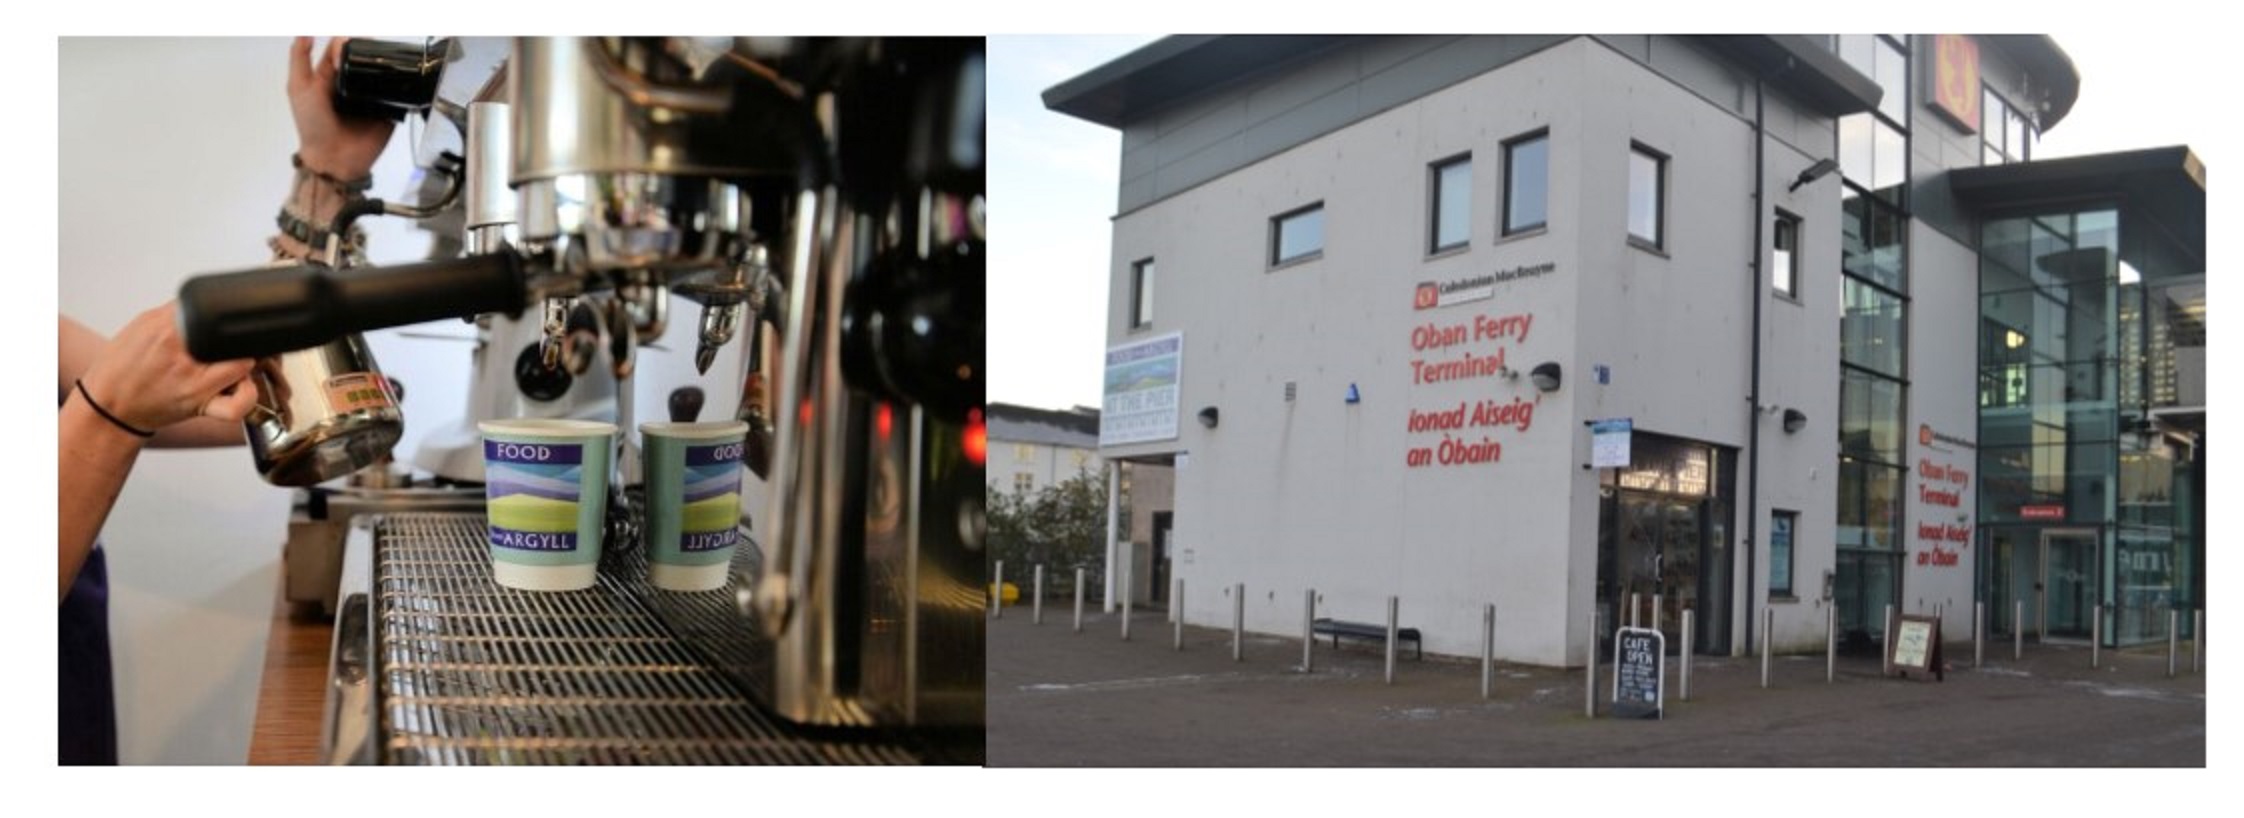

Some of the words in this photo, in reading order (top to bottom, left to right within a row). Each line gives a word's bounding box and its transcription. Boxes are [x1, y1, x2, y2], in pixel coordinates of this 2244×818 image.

[1411, 323, 1467, 350] Oban
[1474, 313, 1534, 343] Ferry
[1410, 347, 1504, 384] Terminal
[497, 443, 551, 460] FOOD
[1407, 447, 1432, 467] an
[1438, 432, 1501, 466] Òbain
[1919, 458, 1945, 480] Oban
[1946, 463, 1969, 489] Ferry
[1919, 484, 1960, 508] Terminal
[503, 533, 569, 548] ARGYLL
[1624, 637, 1650, 651] CAFE
[1627, 650, 1653, 665] OPEN
